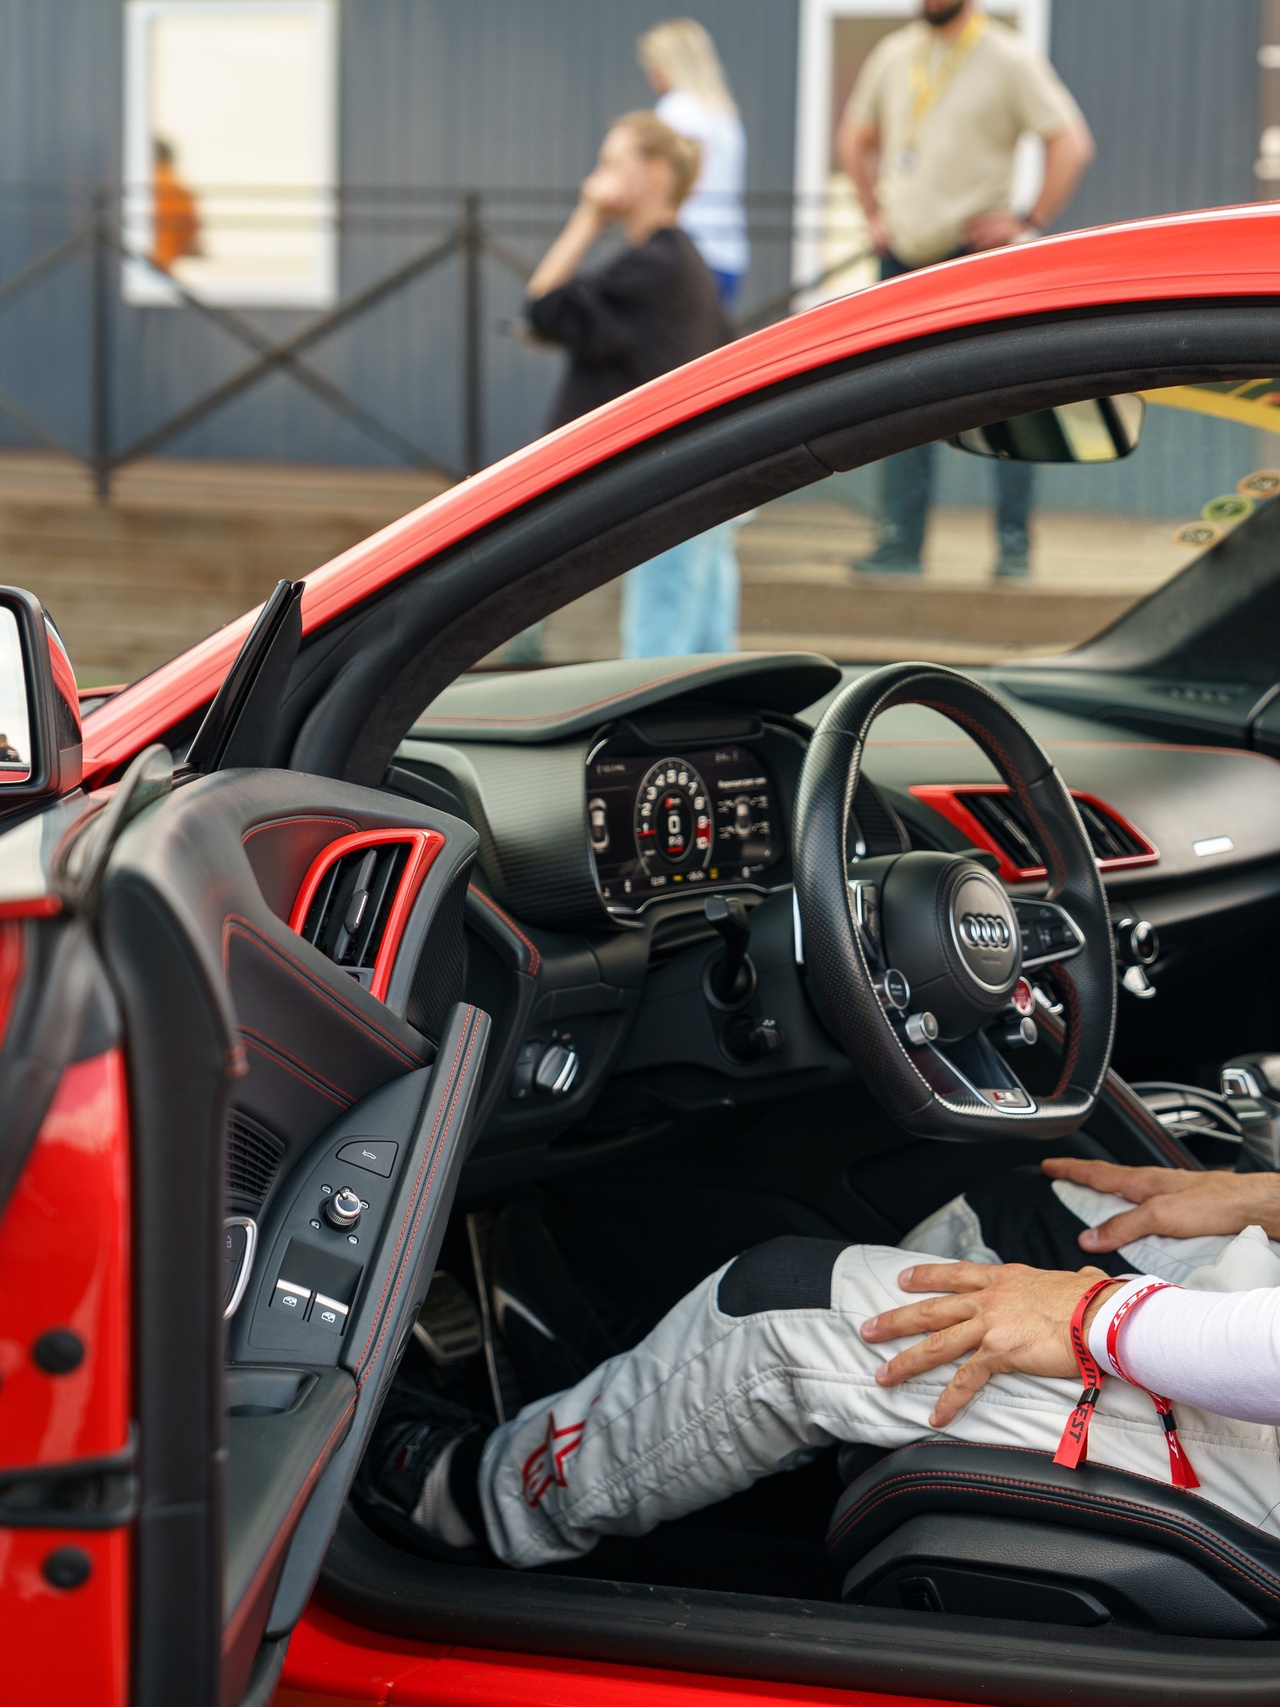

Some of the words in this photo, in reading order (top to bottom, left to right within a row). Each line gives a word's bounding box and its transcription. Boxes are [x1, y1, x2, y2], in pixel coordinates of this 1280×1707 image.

[654, 774, 666, 787] 4
[666, 769, 677, 783] 5
[678, 772, 689, 786] 6
[646, 786, 658, 800] 3
[688, 782, 698, 795] 7
[641, 802, 652, 816] 2
[667, 815, 681, 834] 0
[1112, 1288, 1149, 1331] FEST
